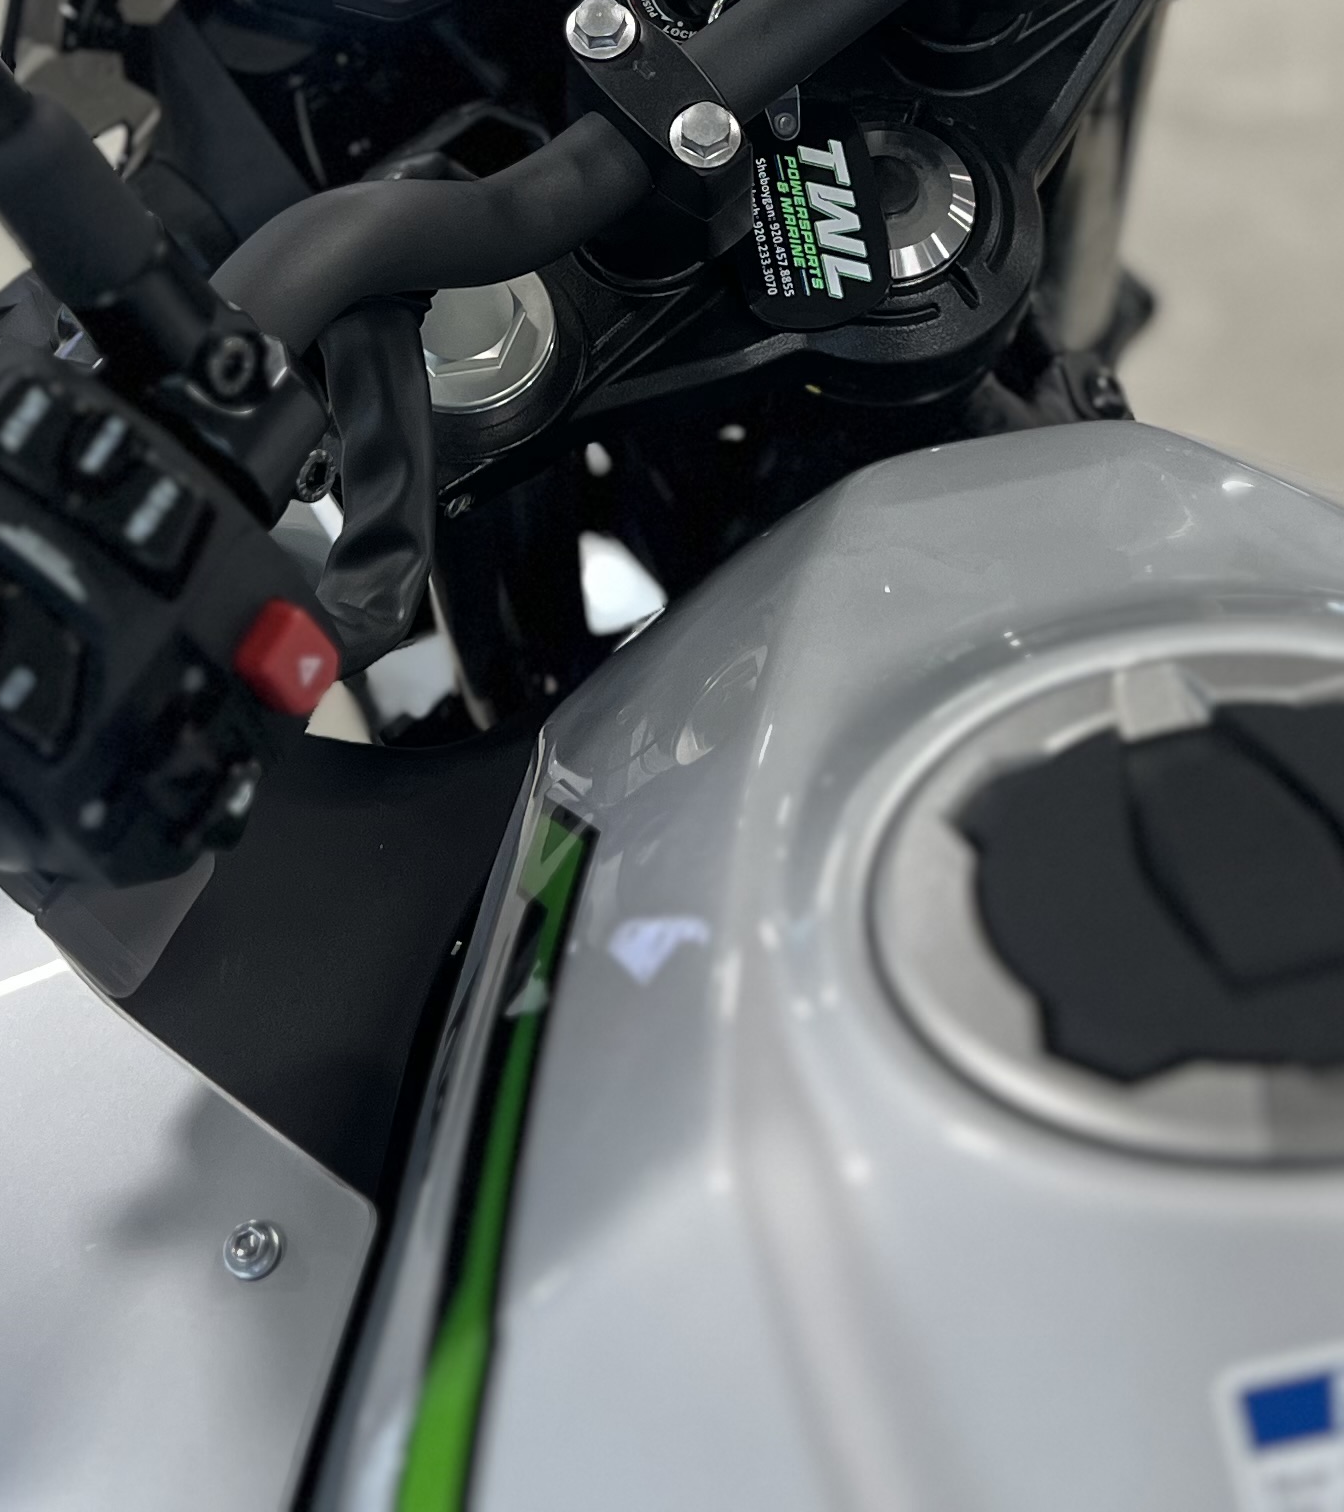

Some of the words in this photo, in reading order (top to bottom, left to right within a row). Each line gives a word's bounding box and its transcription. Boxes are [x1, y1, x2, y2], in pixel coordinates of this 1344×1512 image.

[753, 221, 778, 296] 920.233.3070
[755, 157, 776, 222] Sheboygan:
[769, 222, 795, 298] 920.457.8855
[780, 196, 806, 269] MARINE
[784, 155, 824, 290] POWERSPORTS
[796, 139, 872, 299] TWL
